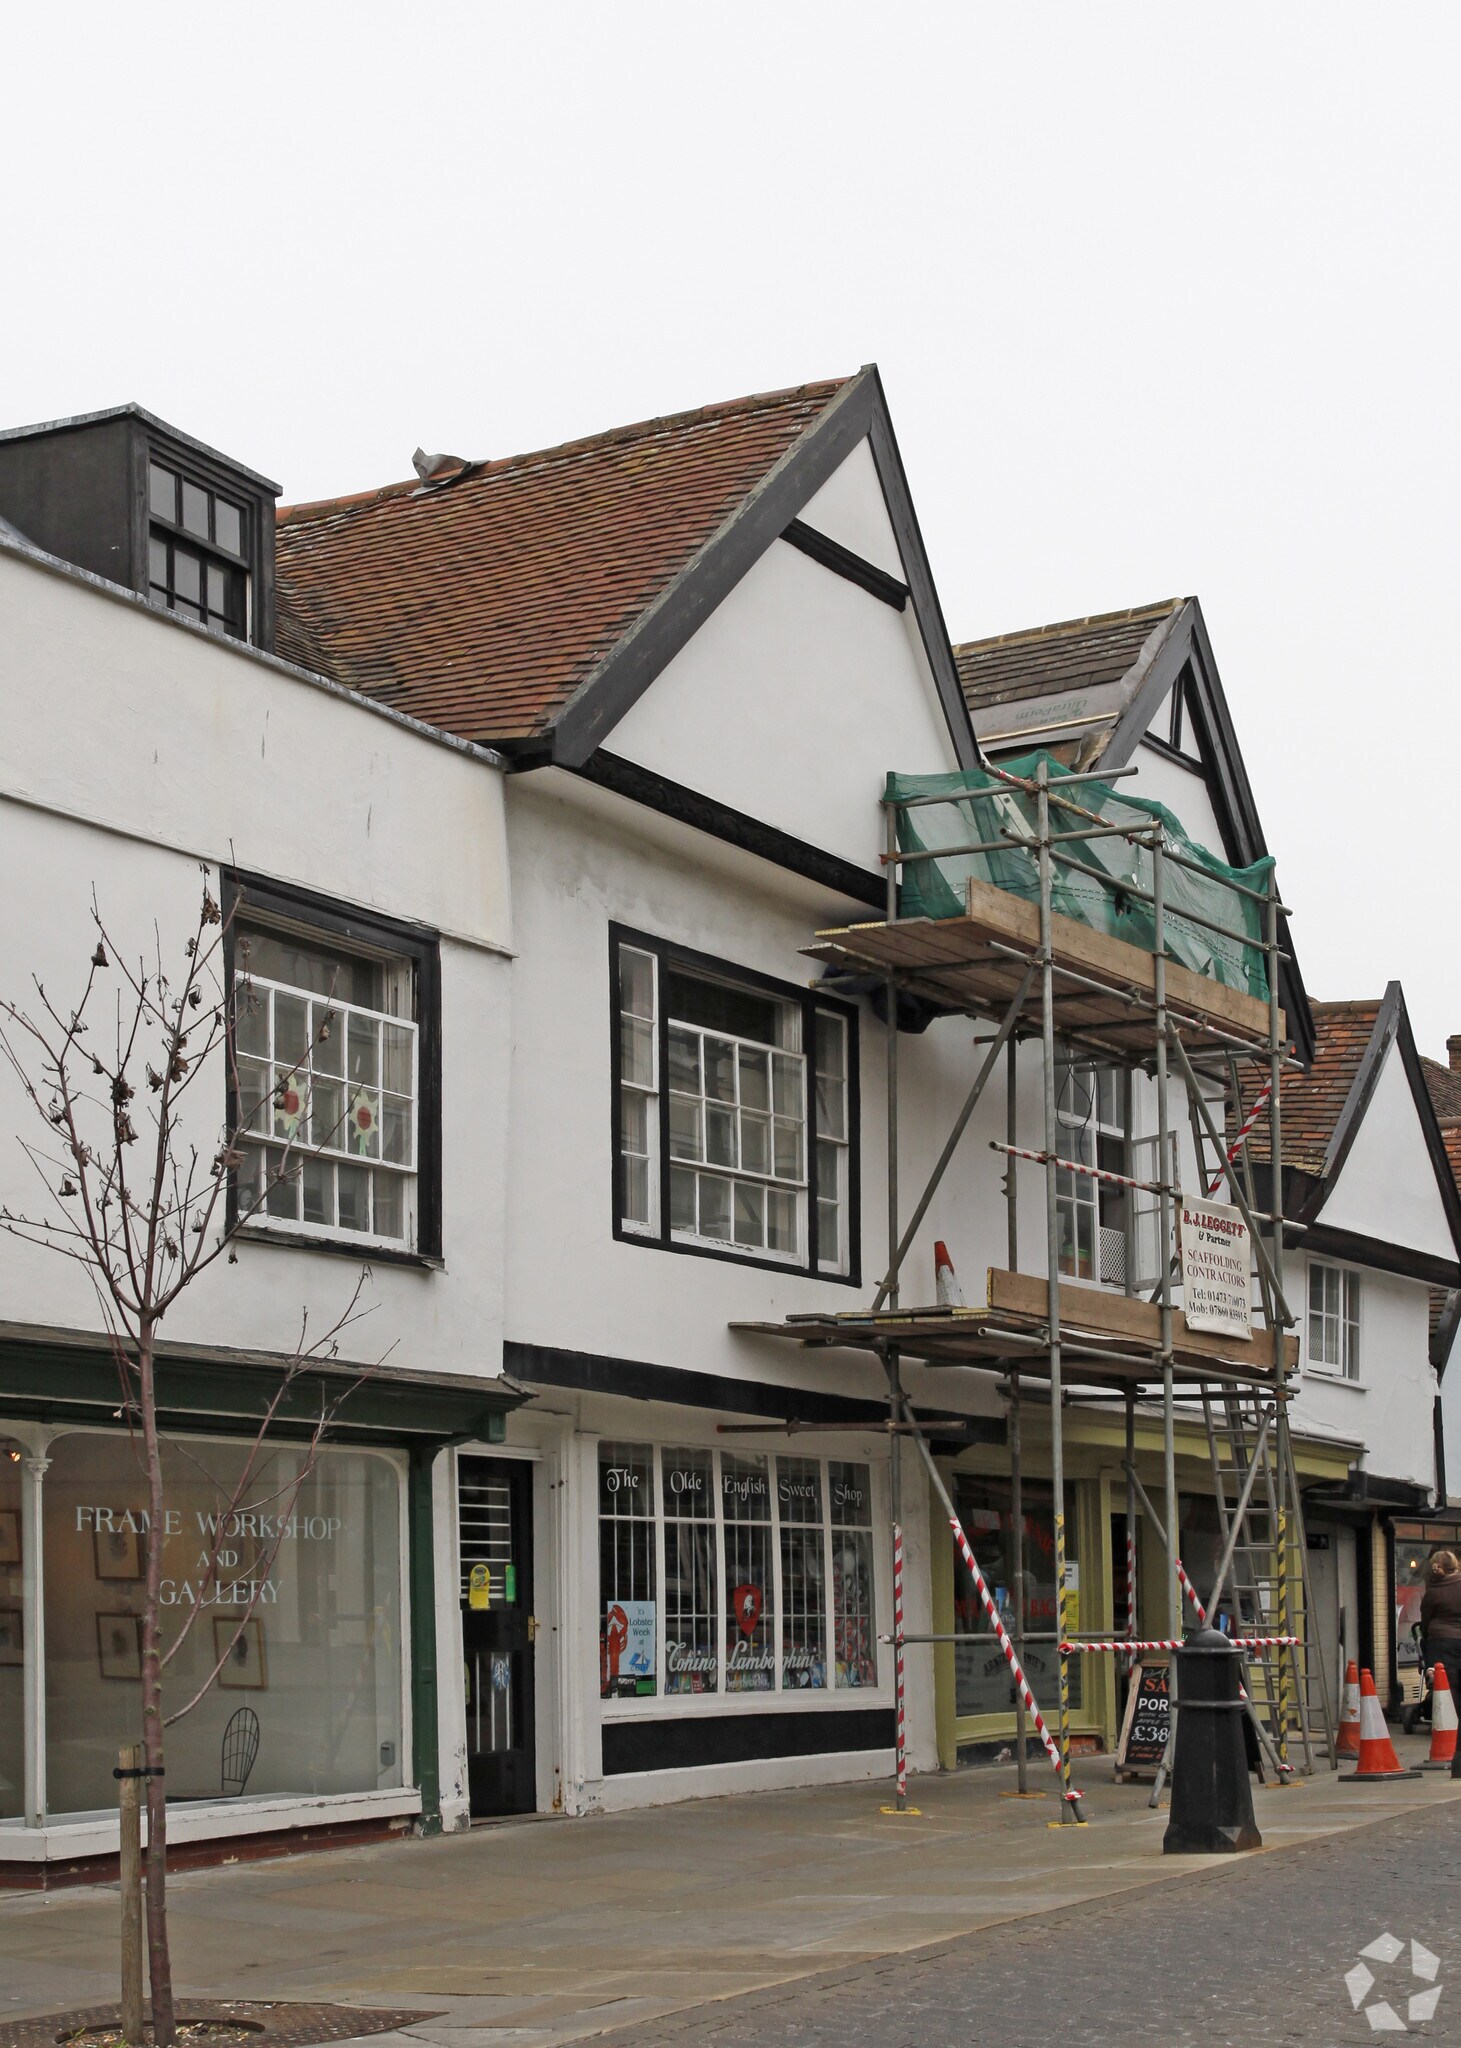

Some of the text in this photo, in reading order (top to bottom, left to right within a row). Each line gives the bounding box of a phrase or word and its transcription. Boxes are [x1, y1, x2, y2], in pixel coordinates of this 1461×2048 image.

[1206, 1232, 1231, 1247] Partner
[1187, 1249, 1242, 1272] SCAFFOLDING
[1186, 1264, 1246, 1288] CONTRACTORS
[1192, 1287, 1206, 1300] Tel:
[1207, 1290, 1227, 1303] 01473
[1188, 1301, 1208, 1314] Mob:
[606, 1468, 863, 1506] The Olde English Sweet Shop
[196, 1511, 342, 1540] WORKSHOP
[196, 1550, 238, 1567] AND
[629, 1618, 653, 1626] Lobster
[632, 1628, 651, 1636] Week
[665, 1640, 717, 1672] Tonino
[1144, 1678, 1171, 1693] SA
[1138, 1698, 1170, 1711] POR
[1131, 1726, 1170, 1742] £3.8
